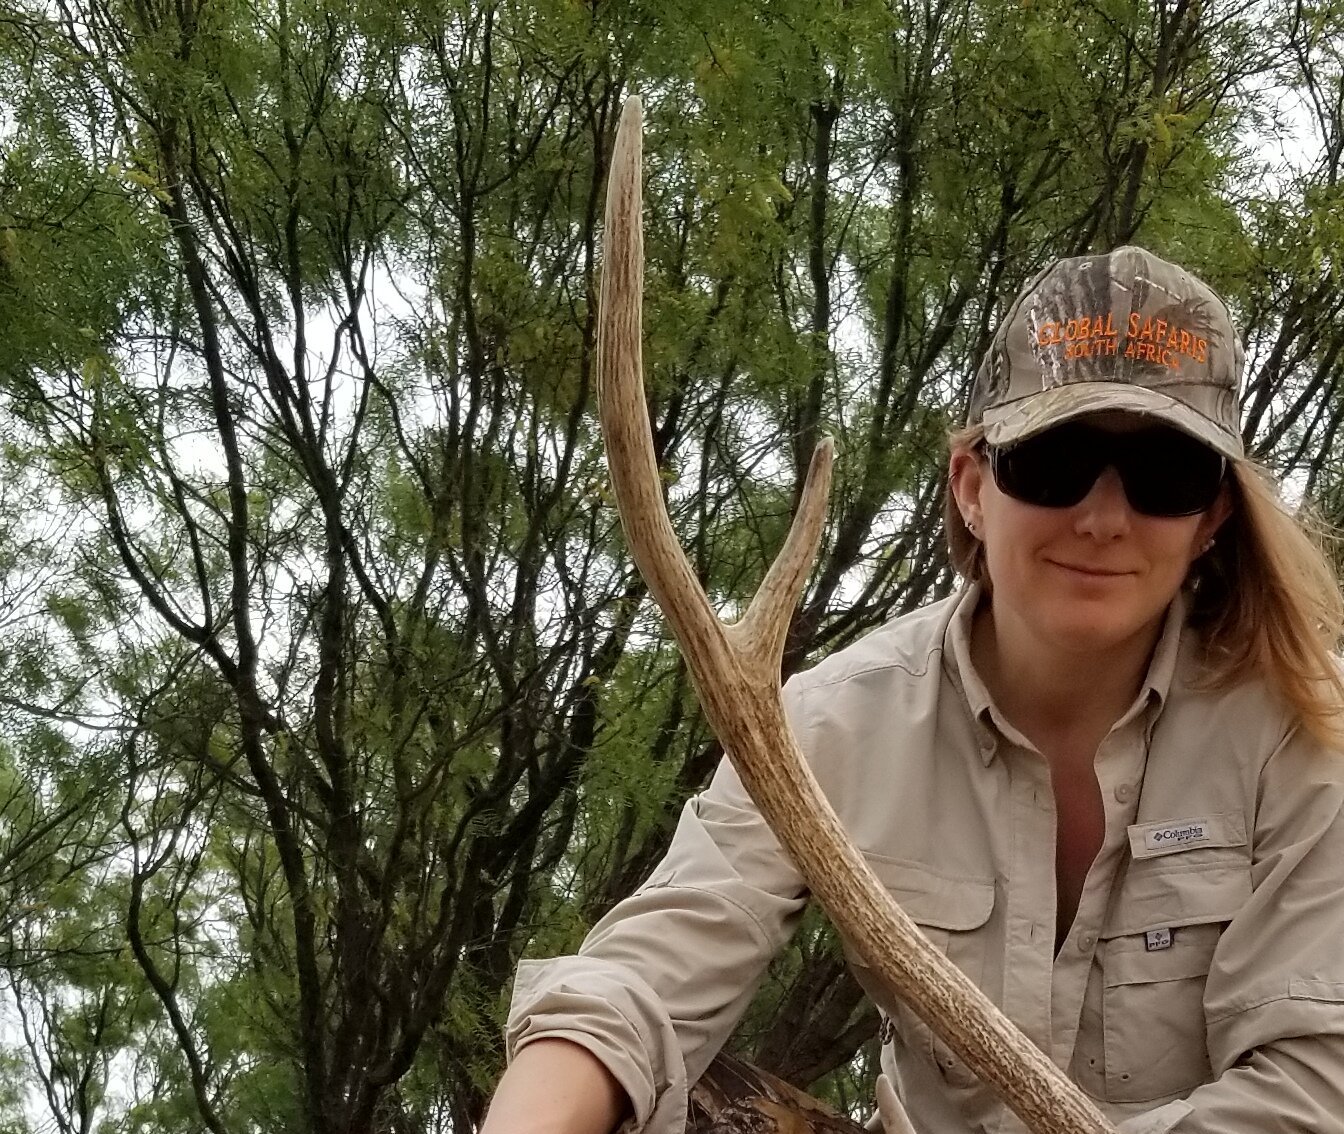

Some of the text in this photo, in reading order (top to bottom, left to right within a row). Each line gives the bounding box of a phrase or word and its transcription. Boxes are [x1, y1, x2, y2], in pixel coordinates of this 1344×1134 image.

[1039, 312, 1208, 364] GLOBAL SAFARIS
[1065, 339, 1181, 370] SOUTH AFRICA
[1163, 826, 1203, 840] Columbia
